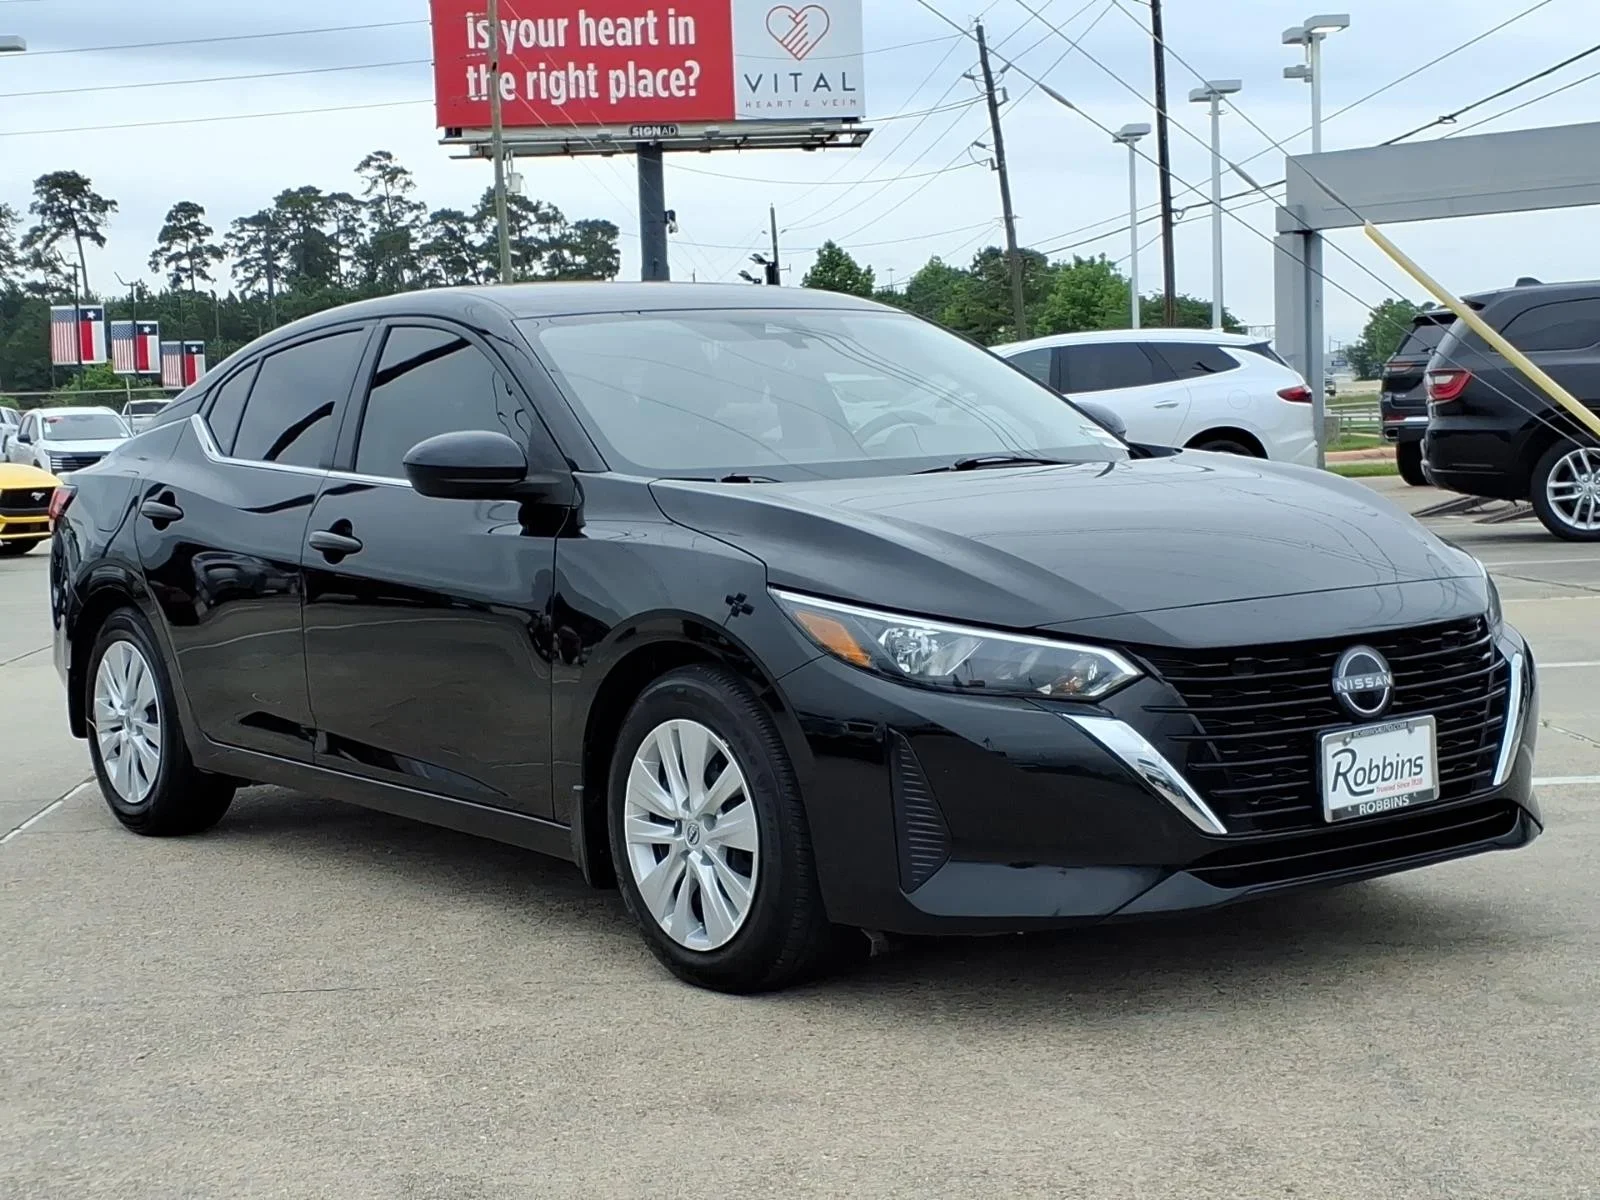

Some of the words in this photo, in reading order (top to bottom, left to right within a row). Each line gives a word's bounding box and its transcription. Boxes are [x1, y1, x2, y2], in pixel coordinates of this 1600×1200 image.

[466, 12, 489, 49] is
[501, 18, 568, 54] your
[579, 9, 658, 47] heart
[668, 8, 696, 45] in
[466, 63, 516, 101] the
[526, 62, 599, 105] right
[608, 60, 701, 105] place?
[744, 71, 856, 93] VITAL
[745, 100, 793, 108] HEART
[804, 99, 810, 107] &
[822, 98, 857, 107] VEIN
[1336, 674, 1391, 691] NISSAN
[1331, 748, 1424, 797] Robbins
[1359, 795, 1410, 815] ROBBINS
